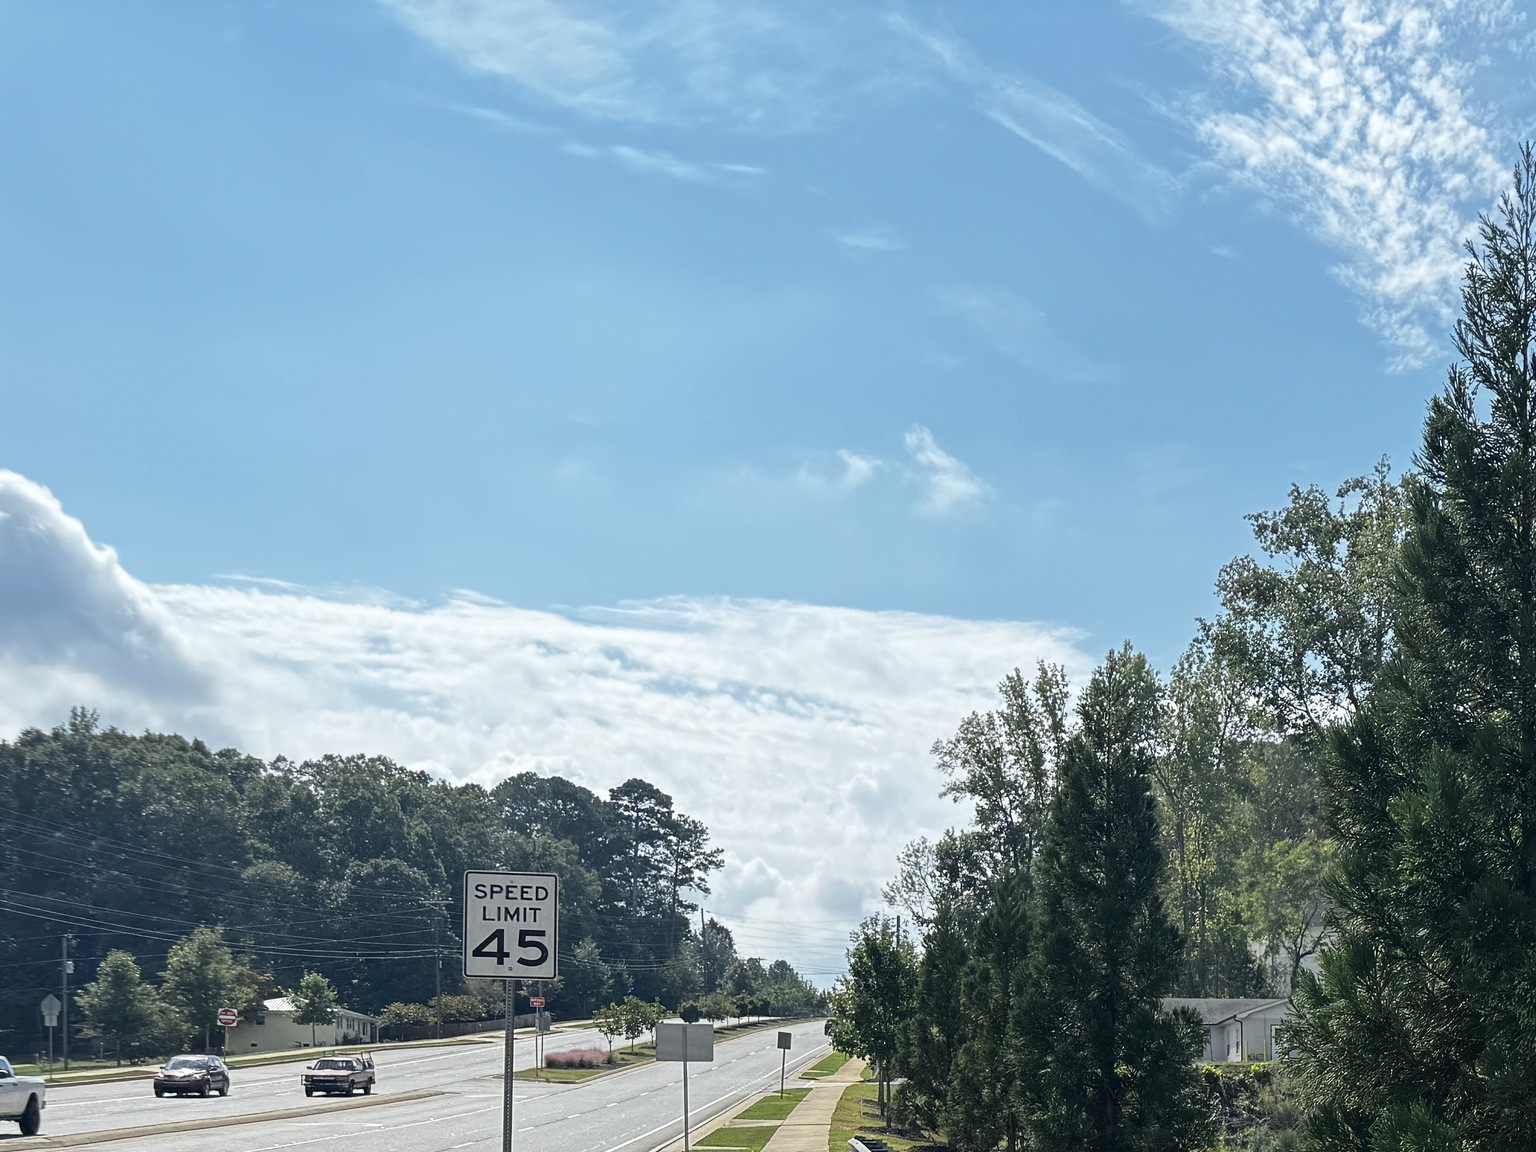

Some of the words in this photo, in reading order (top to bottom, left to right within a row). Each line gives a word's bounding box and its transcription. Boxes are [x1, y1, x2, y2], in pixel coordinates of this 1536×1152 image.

[474, 884, 549, 901] SPEED
[482, 906, 542, 922] LIMIT
[472, 929, 549, 967] 45
